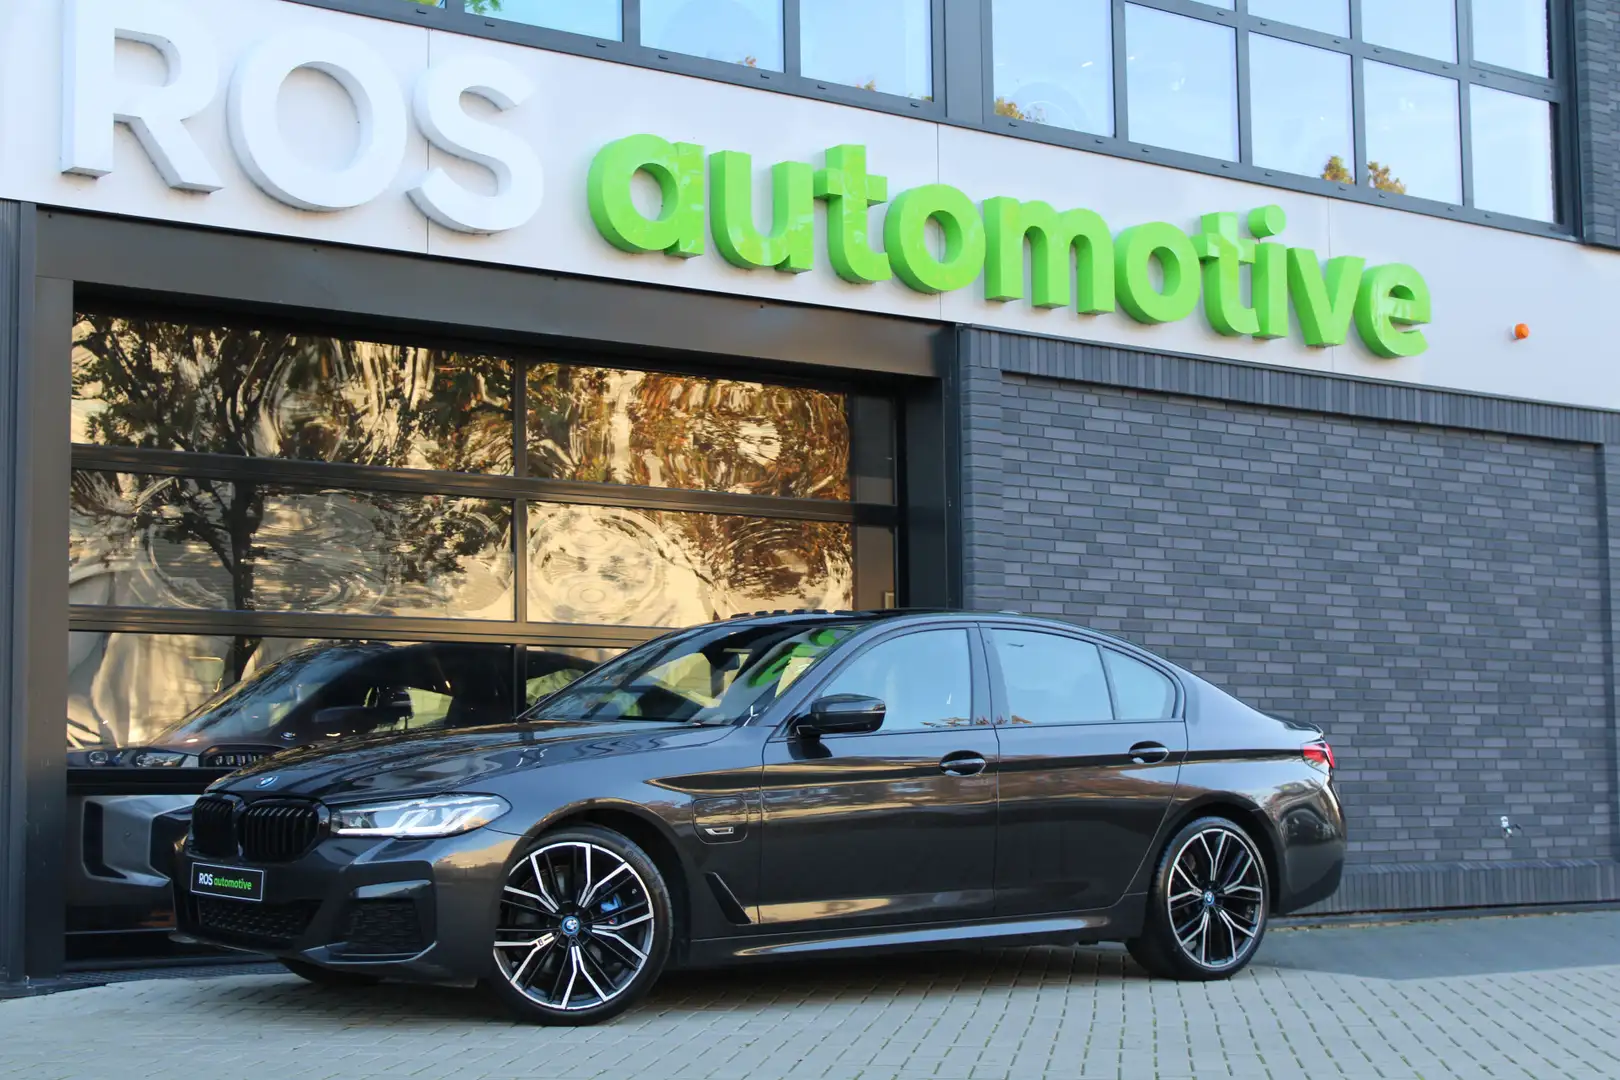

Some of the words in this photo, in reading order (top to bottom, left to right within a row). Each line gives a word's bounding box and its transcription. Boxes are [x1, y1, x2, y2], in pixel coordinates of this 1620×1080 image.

[61, 0, 545, 235] ROS
[587, 133, 1431, 357] automotive
[199, 872, 213, 886] ROS
[214, 876, 252, 890] automotive
